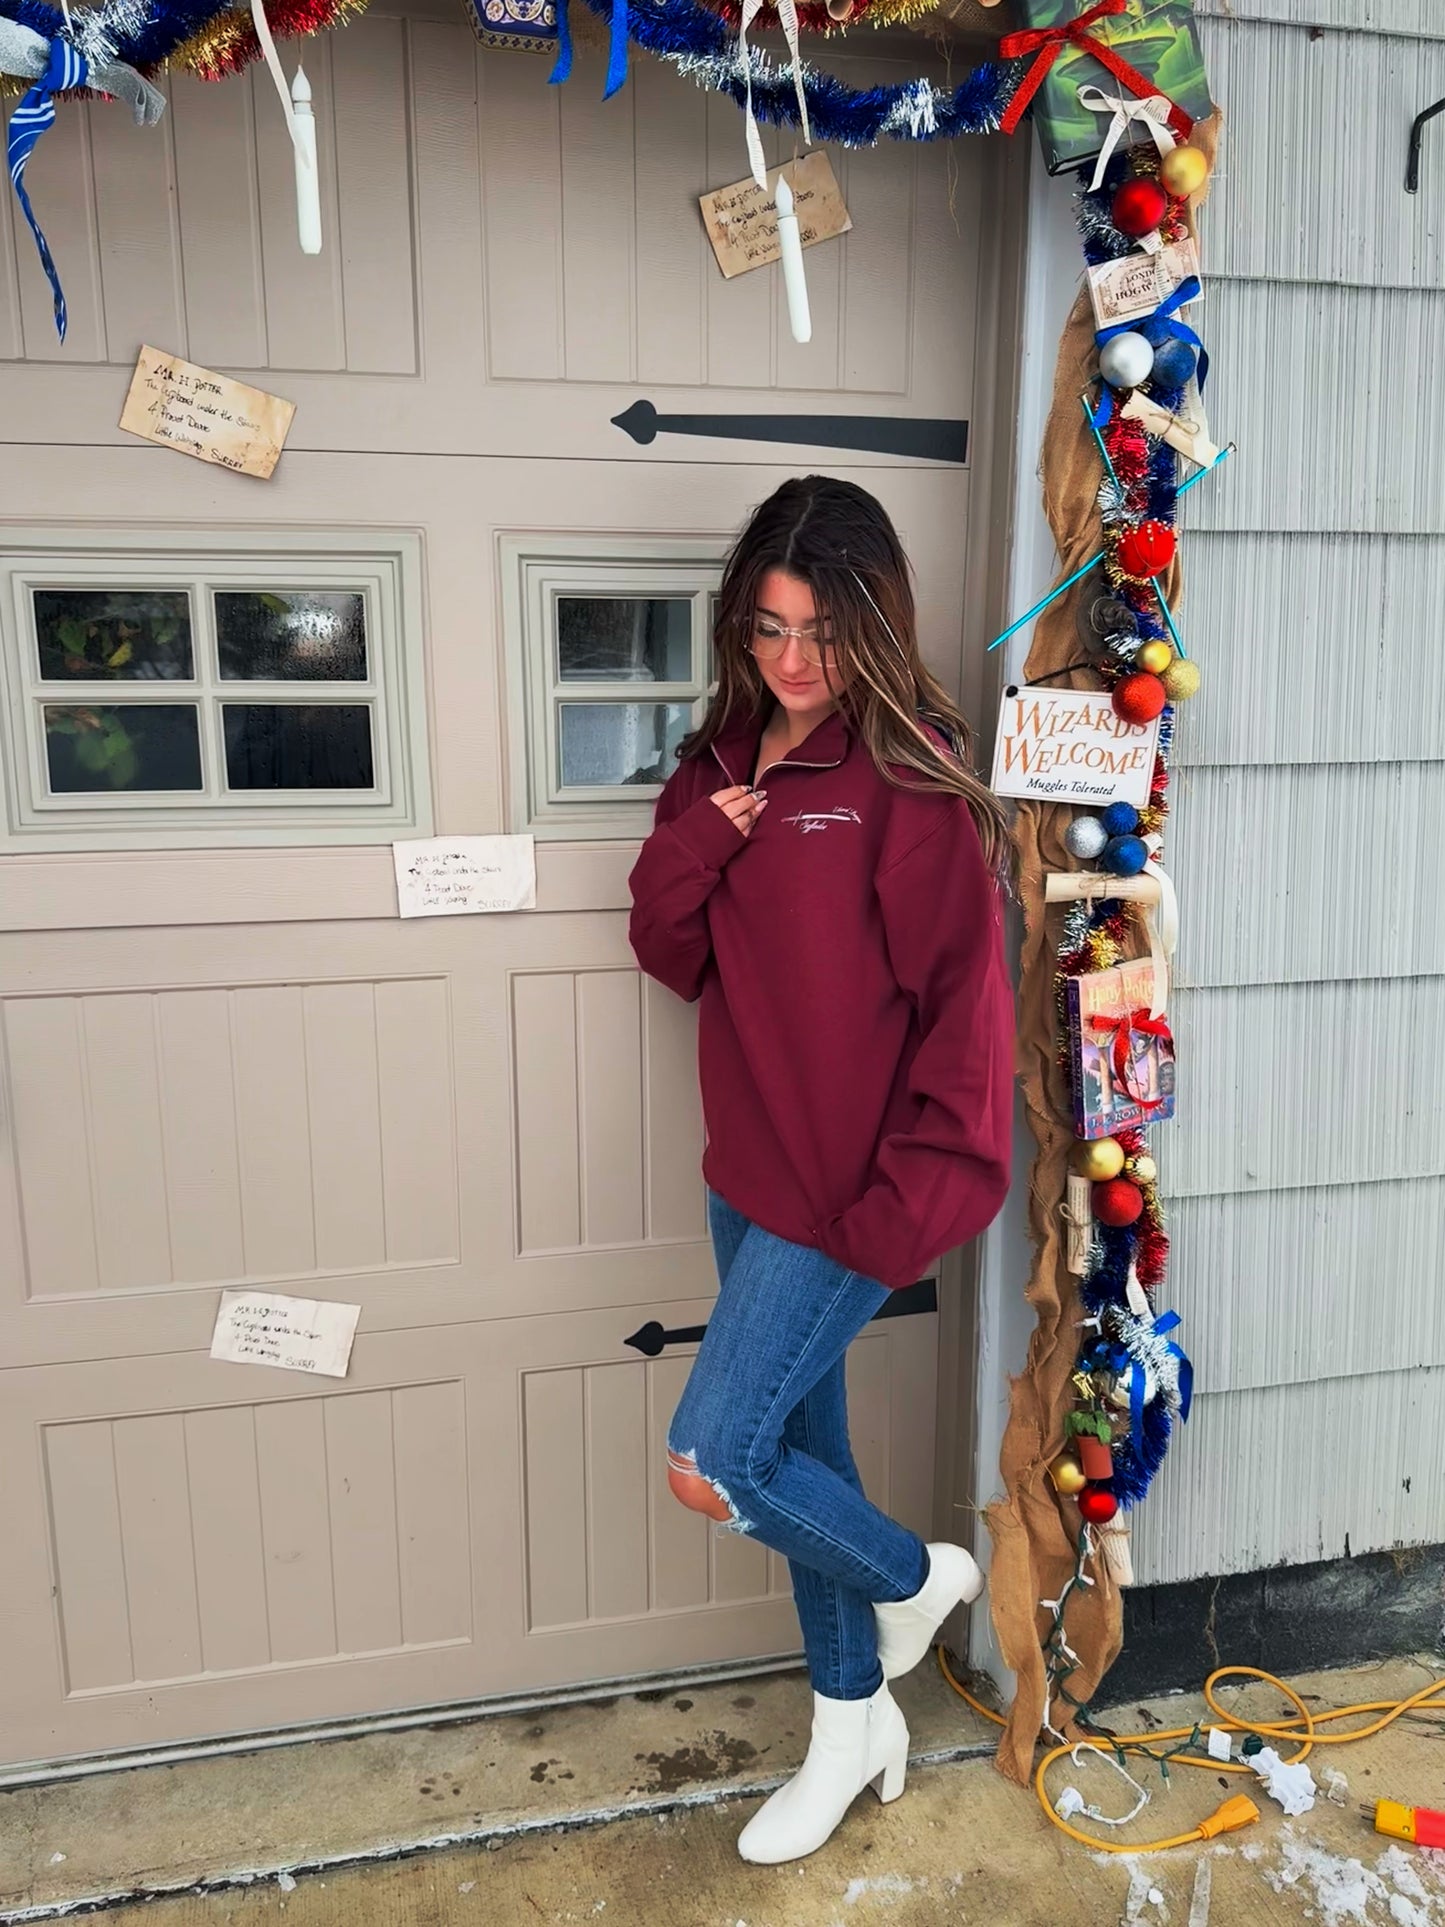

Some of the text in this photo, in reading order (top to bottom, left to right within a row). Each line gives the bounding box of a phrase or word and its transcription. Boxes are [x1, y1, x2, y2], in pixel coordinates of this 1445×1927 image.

[1015, 699, 1148, 739] WIZARDS
[1003, 736, 1148, 775] WELCOME
[1026, 778, 1116, 796] Muggles Tolerated
